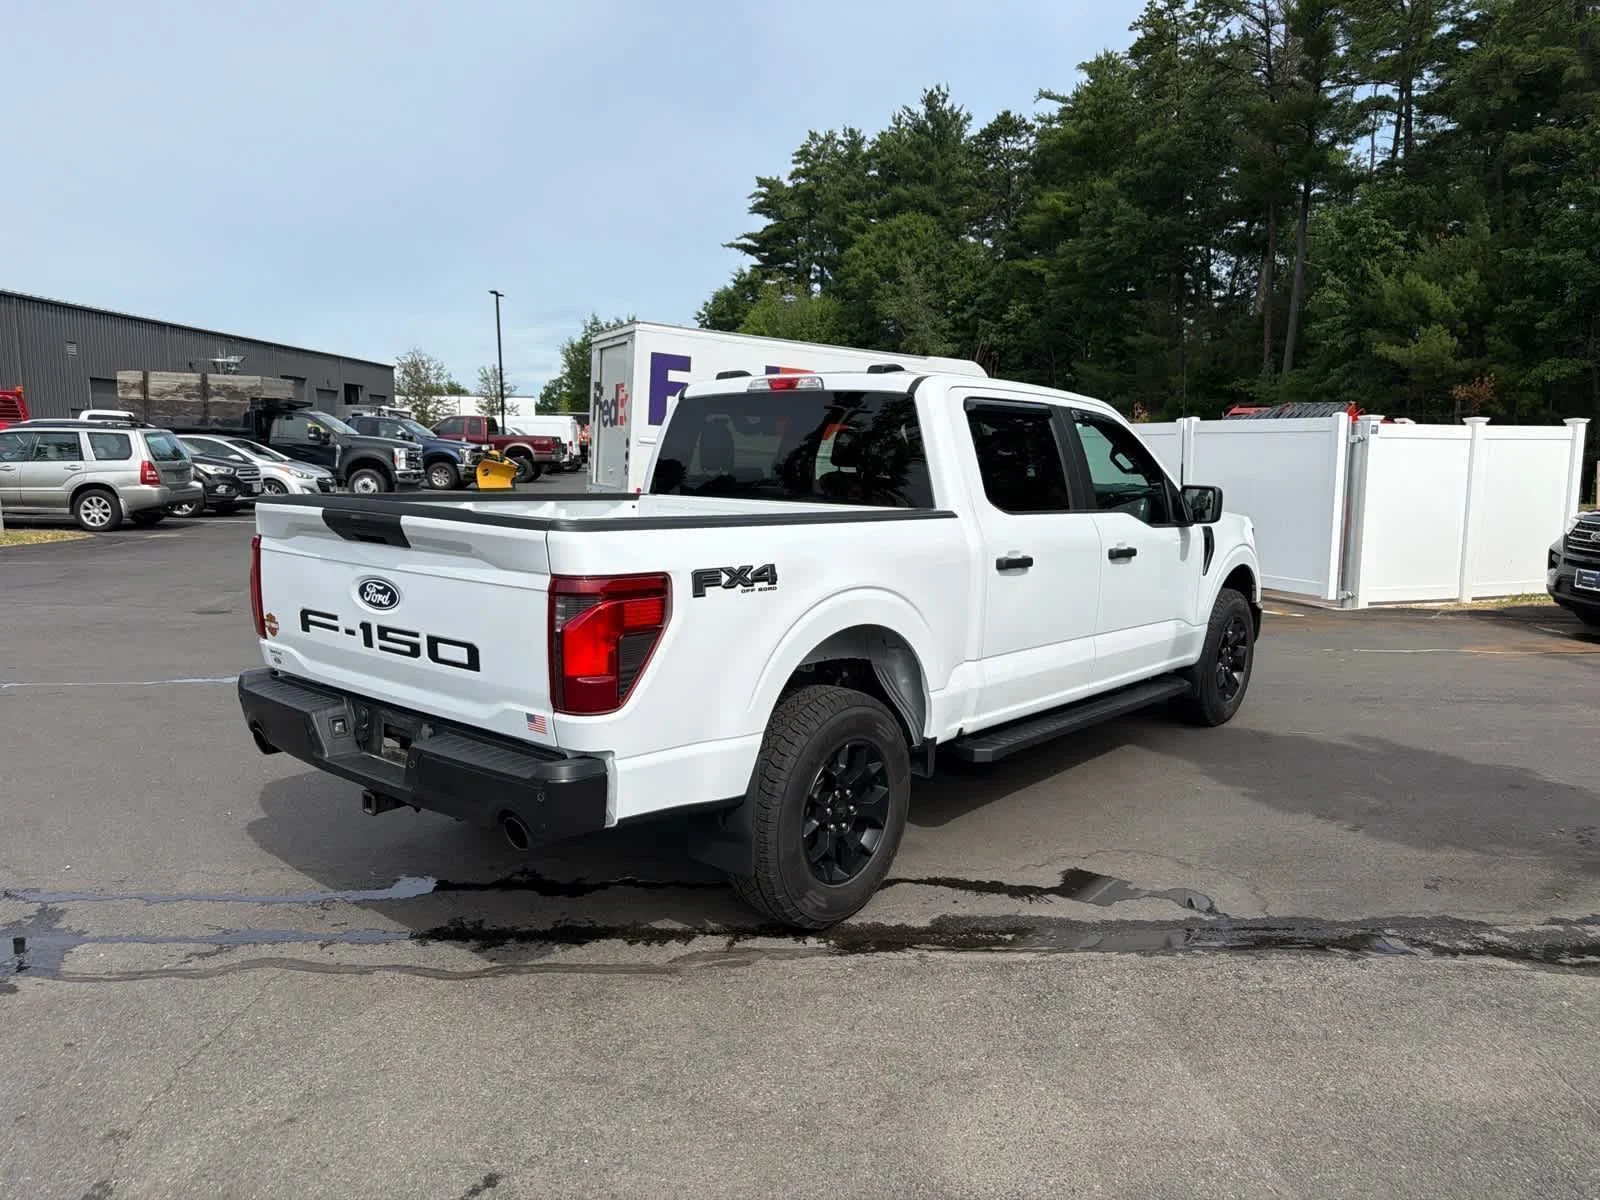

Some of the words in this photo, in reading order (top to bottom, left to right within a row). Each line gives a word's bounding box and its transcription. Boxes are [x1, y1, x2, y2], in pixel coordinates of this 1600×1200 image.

[363, 582, 391, 605] Ford
[691, 564, 778, 598] FX4
[300, 608, 481, 672] F-150
